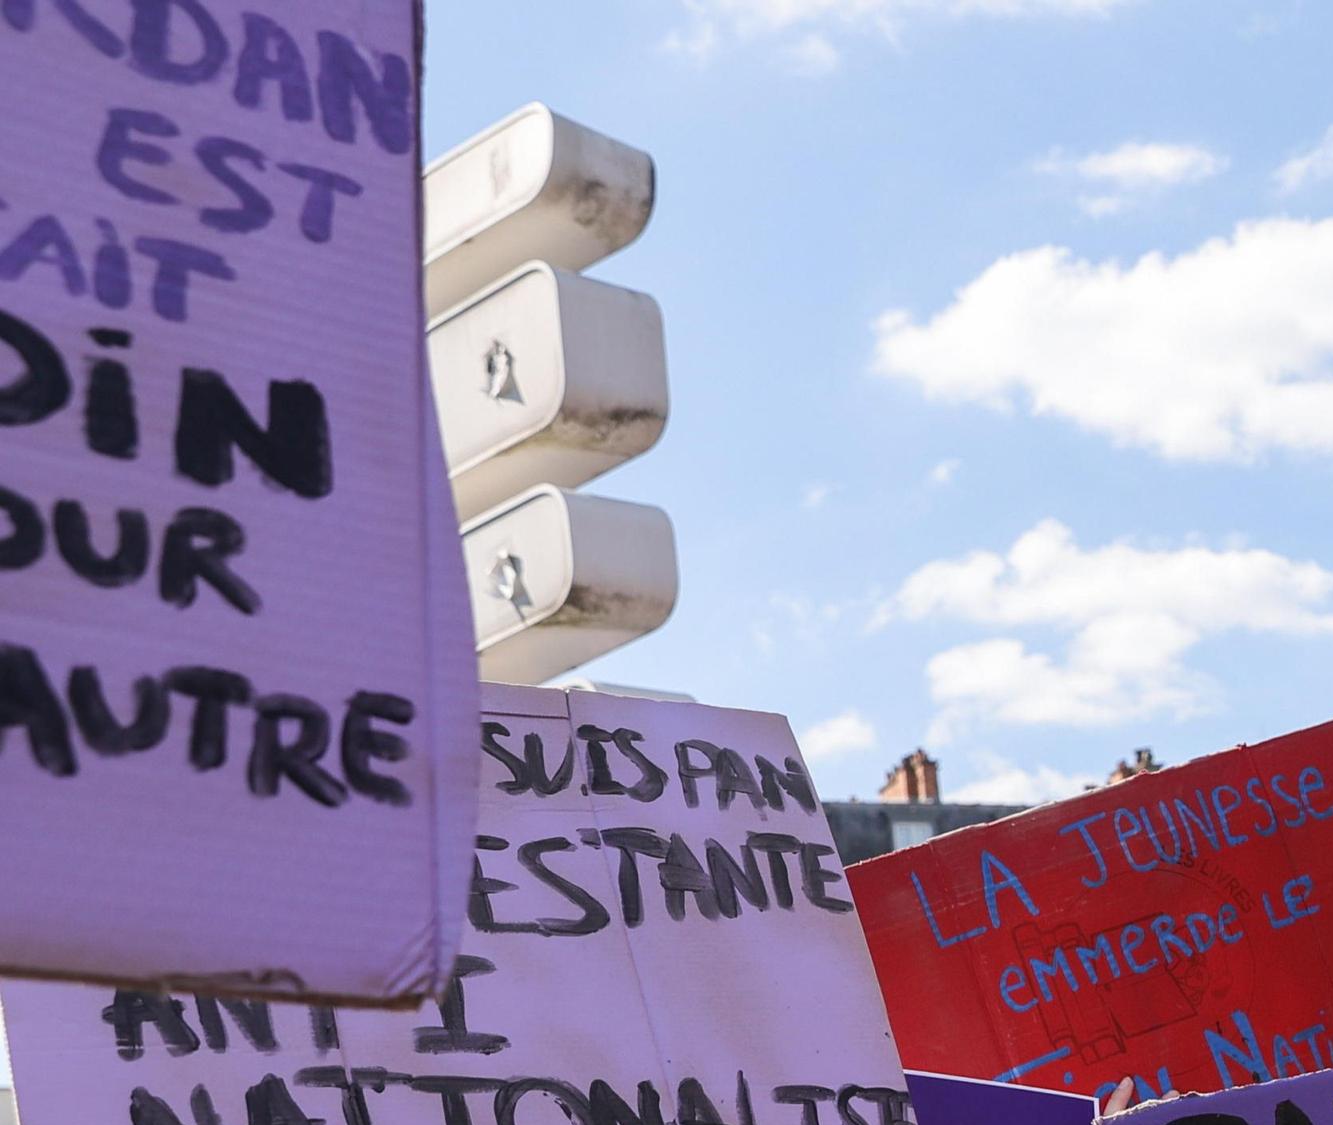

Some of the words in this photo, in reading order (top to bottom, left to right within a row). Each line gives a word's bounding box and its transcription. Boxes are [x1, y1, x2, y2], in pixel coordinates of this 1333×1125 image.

[96, 107, 363, 243] EST
[480, 722, 668, 803] SUIS
[673, 738, 817, 813] PAN
[910, 849, 1040, 949] LA
